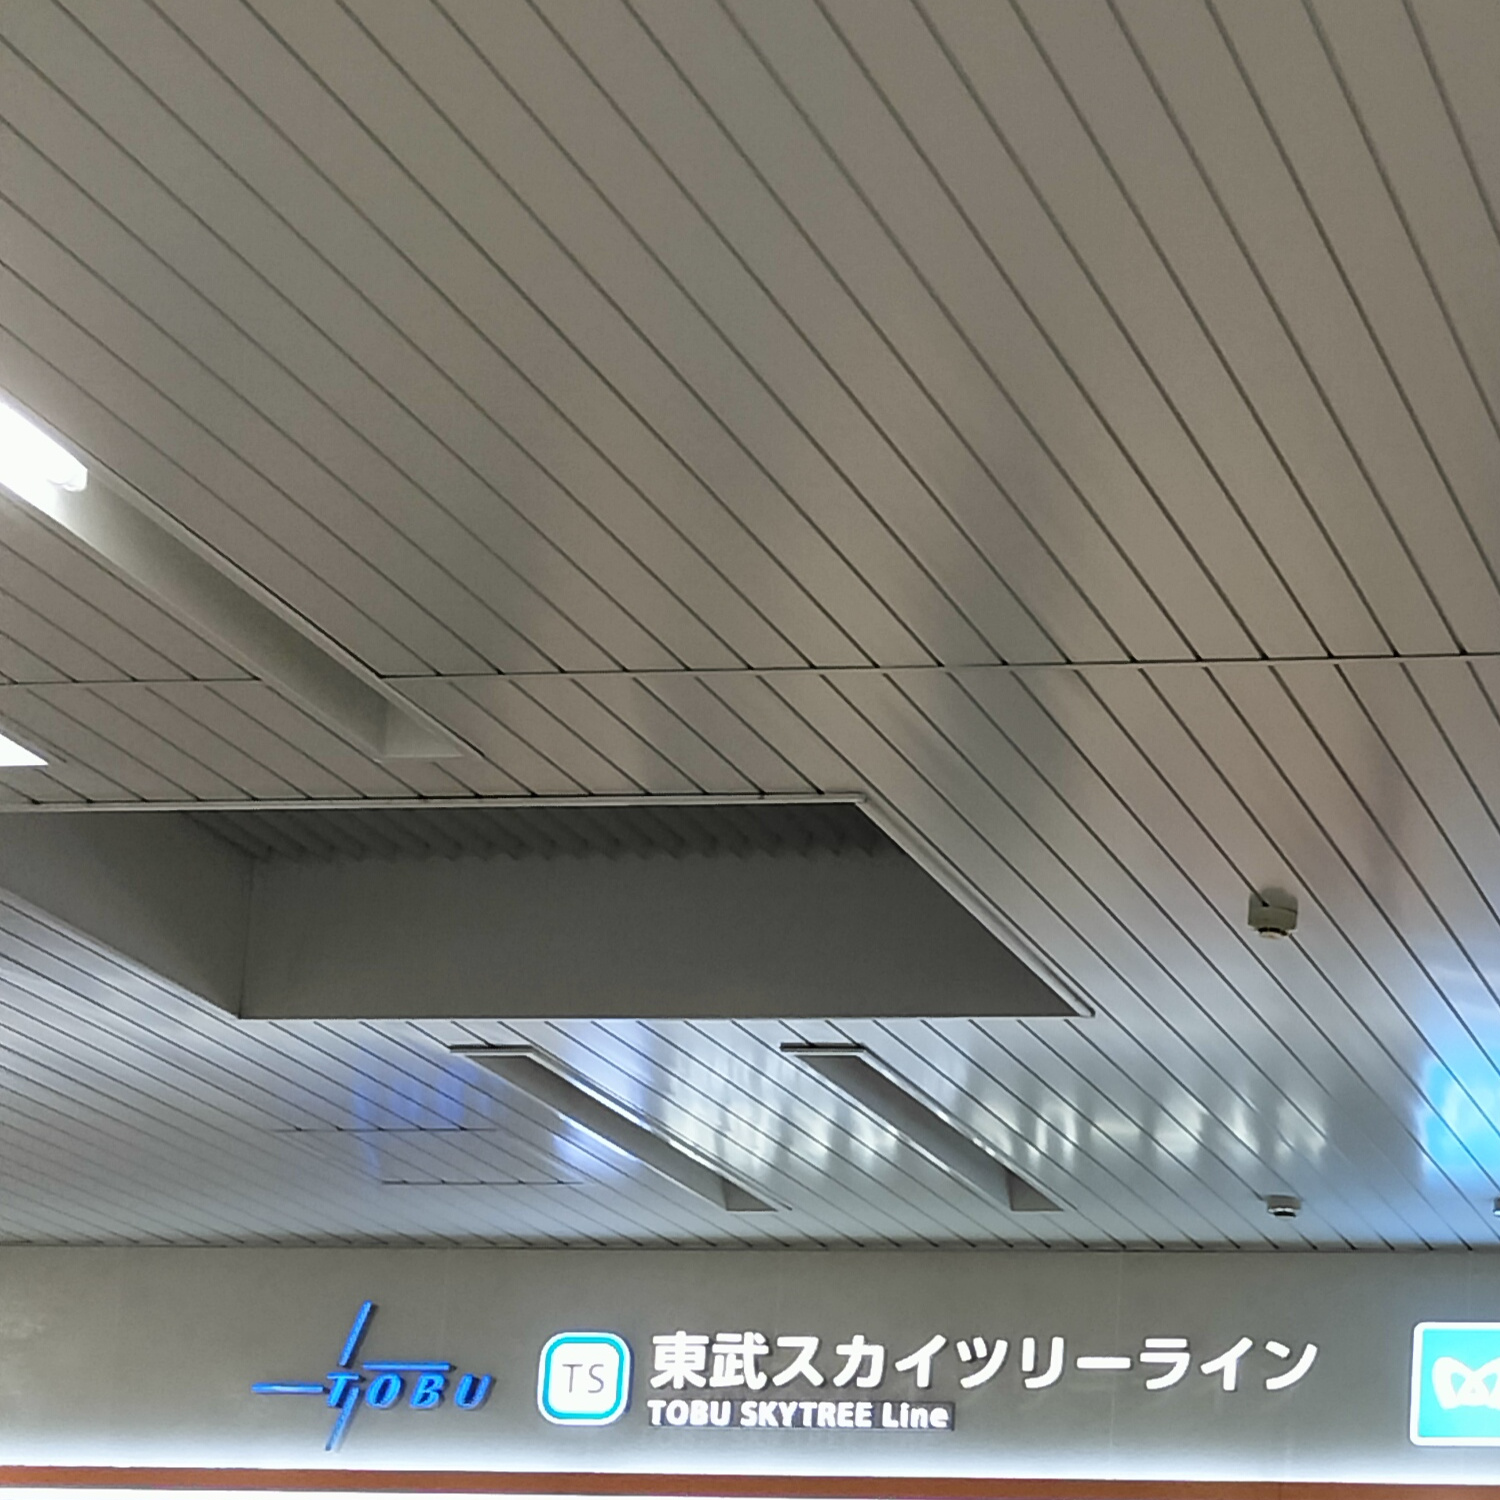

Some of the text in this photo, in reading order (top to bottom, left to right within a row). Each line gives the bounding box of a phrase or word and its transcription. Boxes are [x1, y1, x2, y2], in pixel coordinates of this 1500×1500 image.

[562, 1362, 606, 1395] TS
[649, 1330, 1318, 1393] 東武スカイツリーライン
[326, 1371, 493, 1410] TOBU
[648, 1400, 950, 1430] TOBU SKYTREE Line
